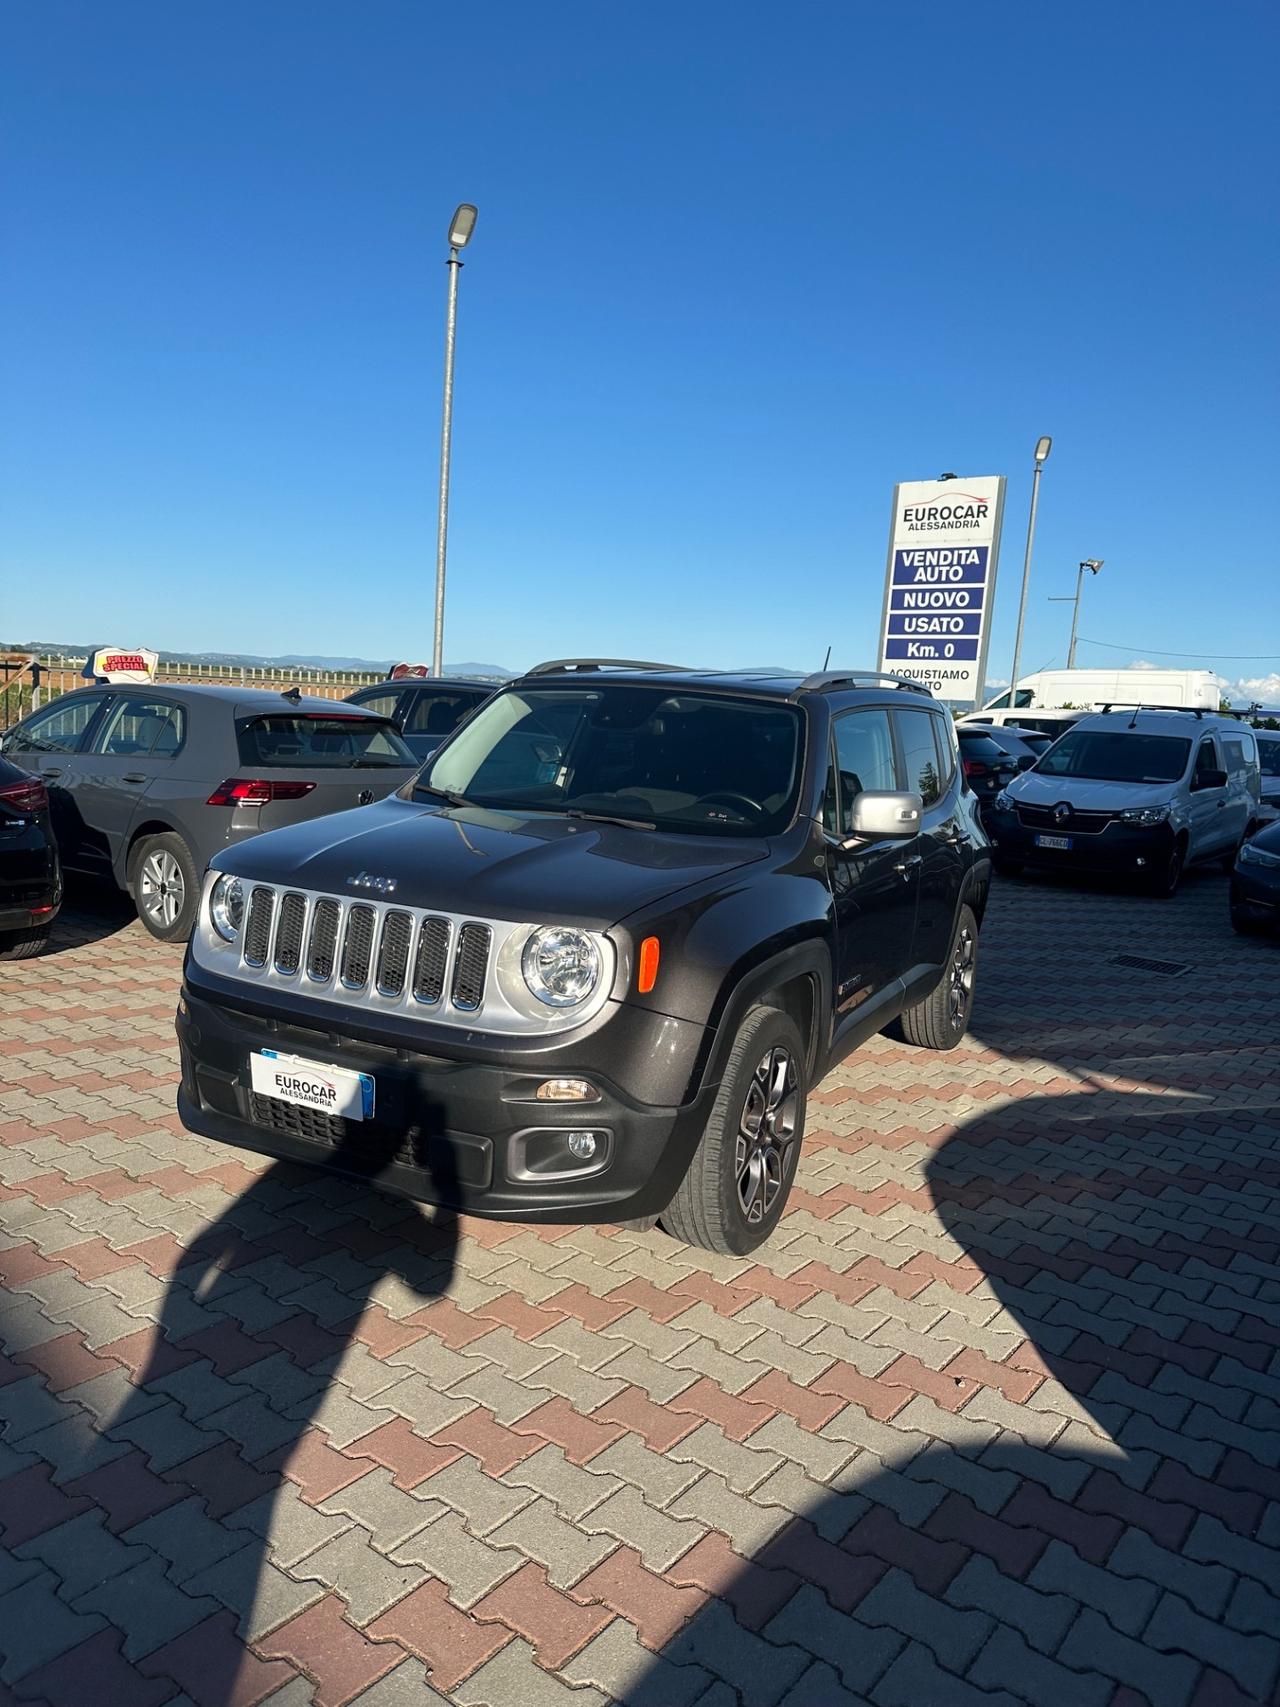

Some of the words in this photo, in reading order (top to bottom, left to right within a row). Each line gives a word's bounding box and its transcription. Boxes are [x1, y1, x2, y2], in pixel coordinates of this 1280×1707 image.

[903, 504, 988, 522] EUROCAR
[908, 520, 980, 532] ALESSANDRIA
[902, 549, 980, 567] VENDITA
[913, 565, 964, 582] AUTO
[903, 591, 970, 608] NUOVO
[903, 617, 964, 633] USATO
[907, 642, 939, 658] Km.
[943, 642, 955, 658] 0
[275, 1074, 337, 1102] EUROCAR
[280, 1087, 333, 1108] ALESSANDRIA
